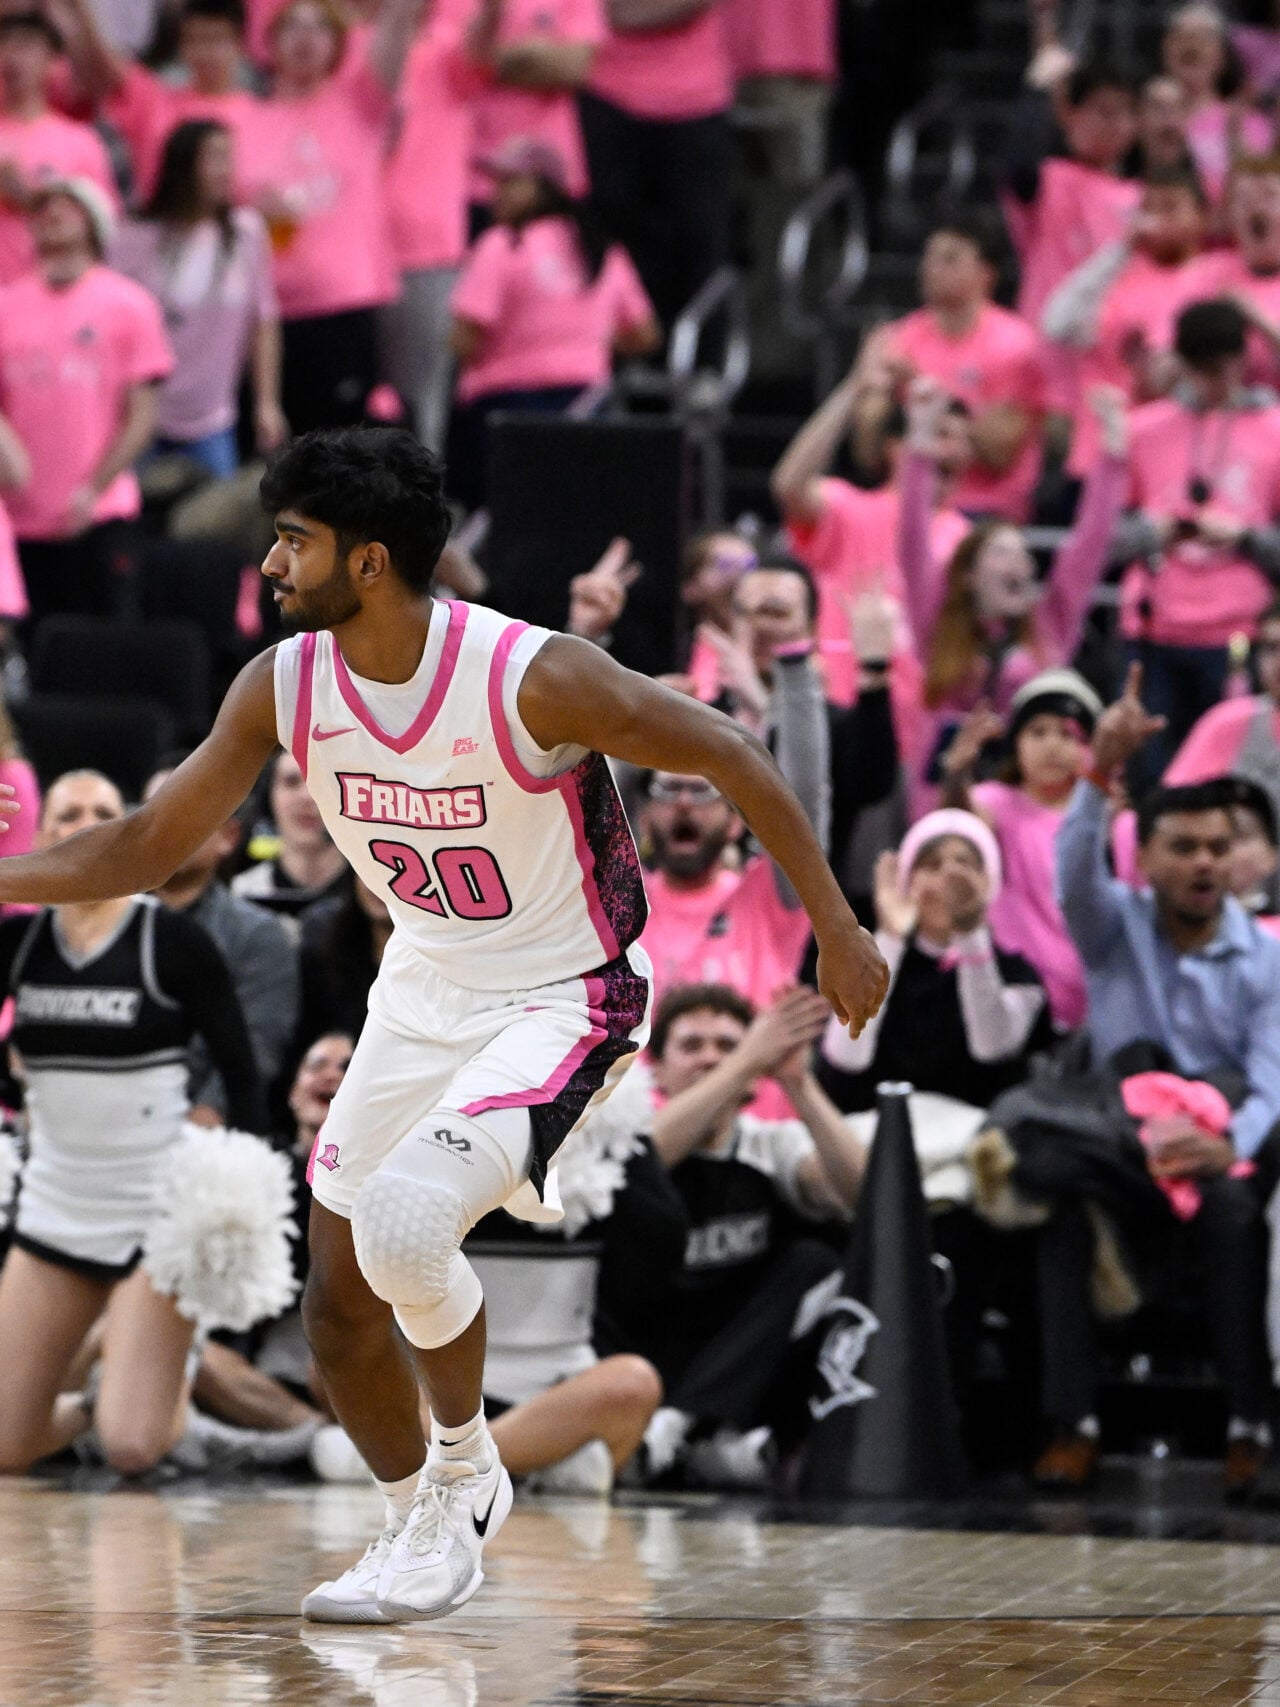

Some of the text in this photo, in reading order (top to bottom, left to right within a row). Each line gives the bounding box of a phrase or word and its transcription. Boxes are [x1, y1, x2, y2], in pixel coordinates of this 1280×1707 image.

[452, 743, 480, 753] EAST
[454, 737, 473, 746] BIG
[341, 776, 483, 828] FRIARS
[368, 839, 513, 920] 20
